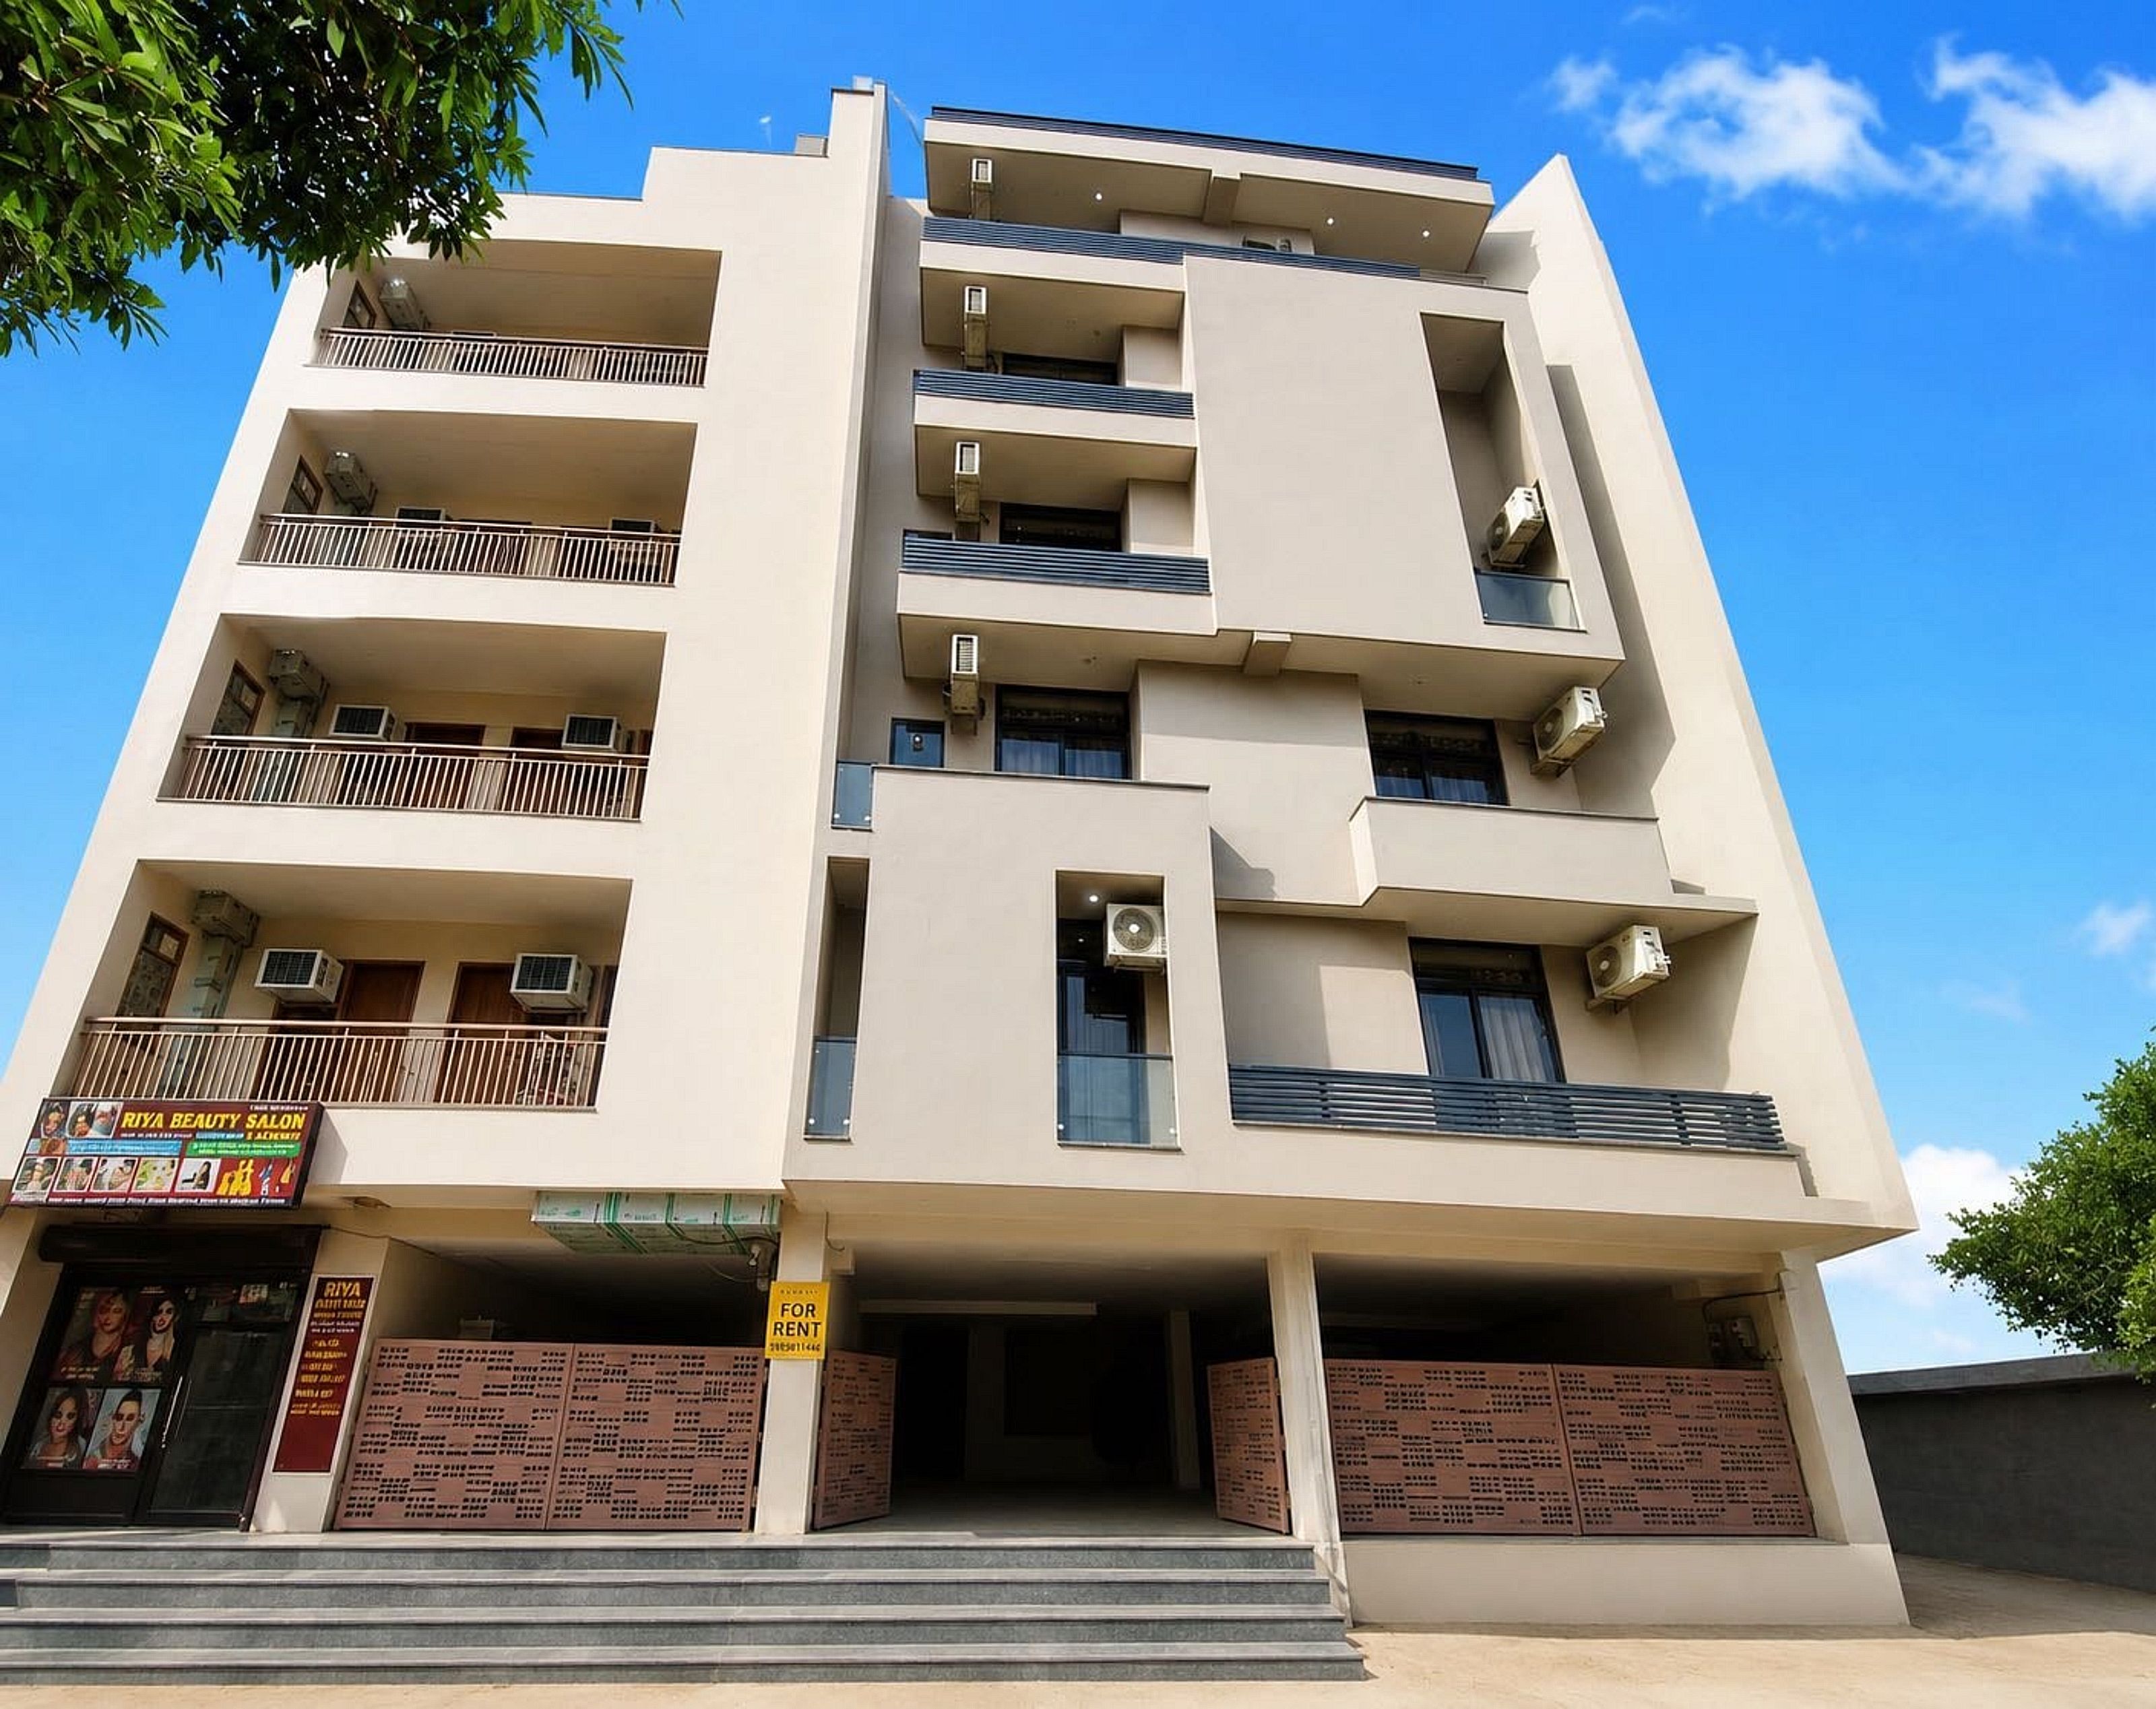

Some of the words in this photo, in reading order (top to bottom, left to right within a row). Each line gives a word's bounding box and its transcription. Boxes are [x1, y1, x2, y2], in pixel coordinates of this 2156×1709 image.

[121, 1111, 164, 1128] RIYA
[169, 1113, 241, 1129] BEAUTY
[245, 1113, 306, 1130] SALON
[323, 1281, 360, 1298] RIYA
[780, 1303, 817, 1318] FOR
[773, 1321, 821, 1338] RENT
